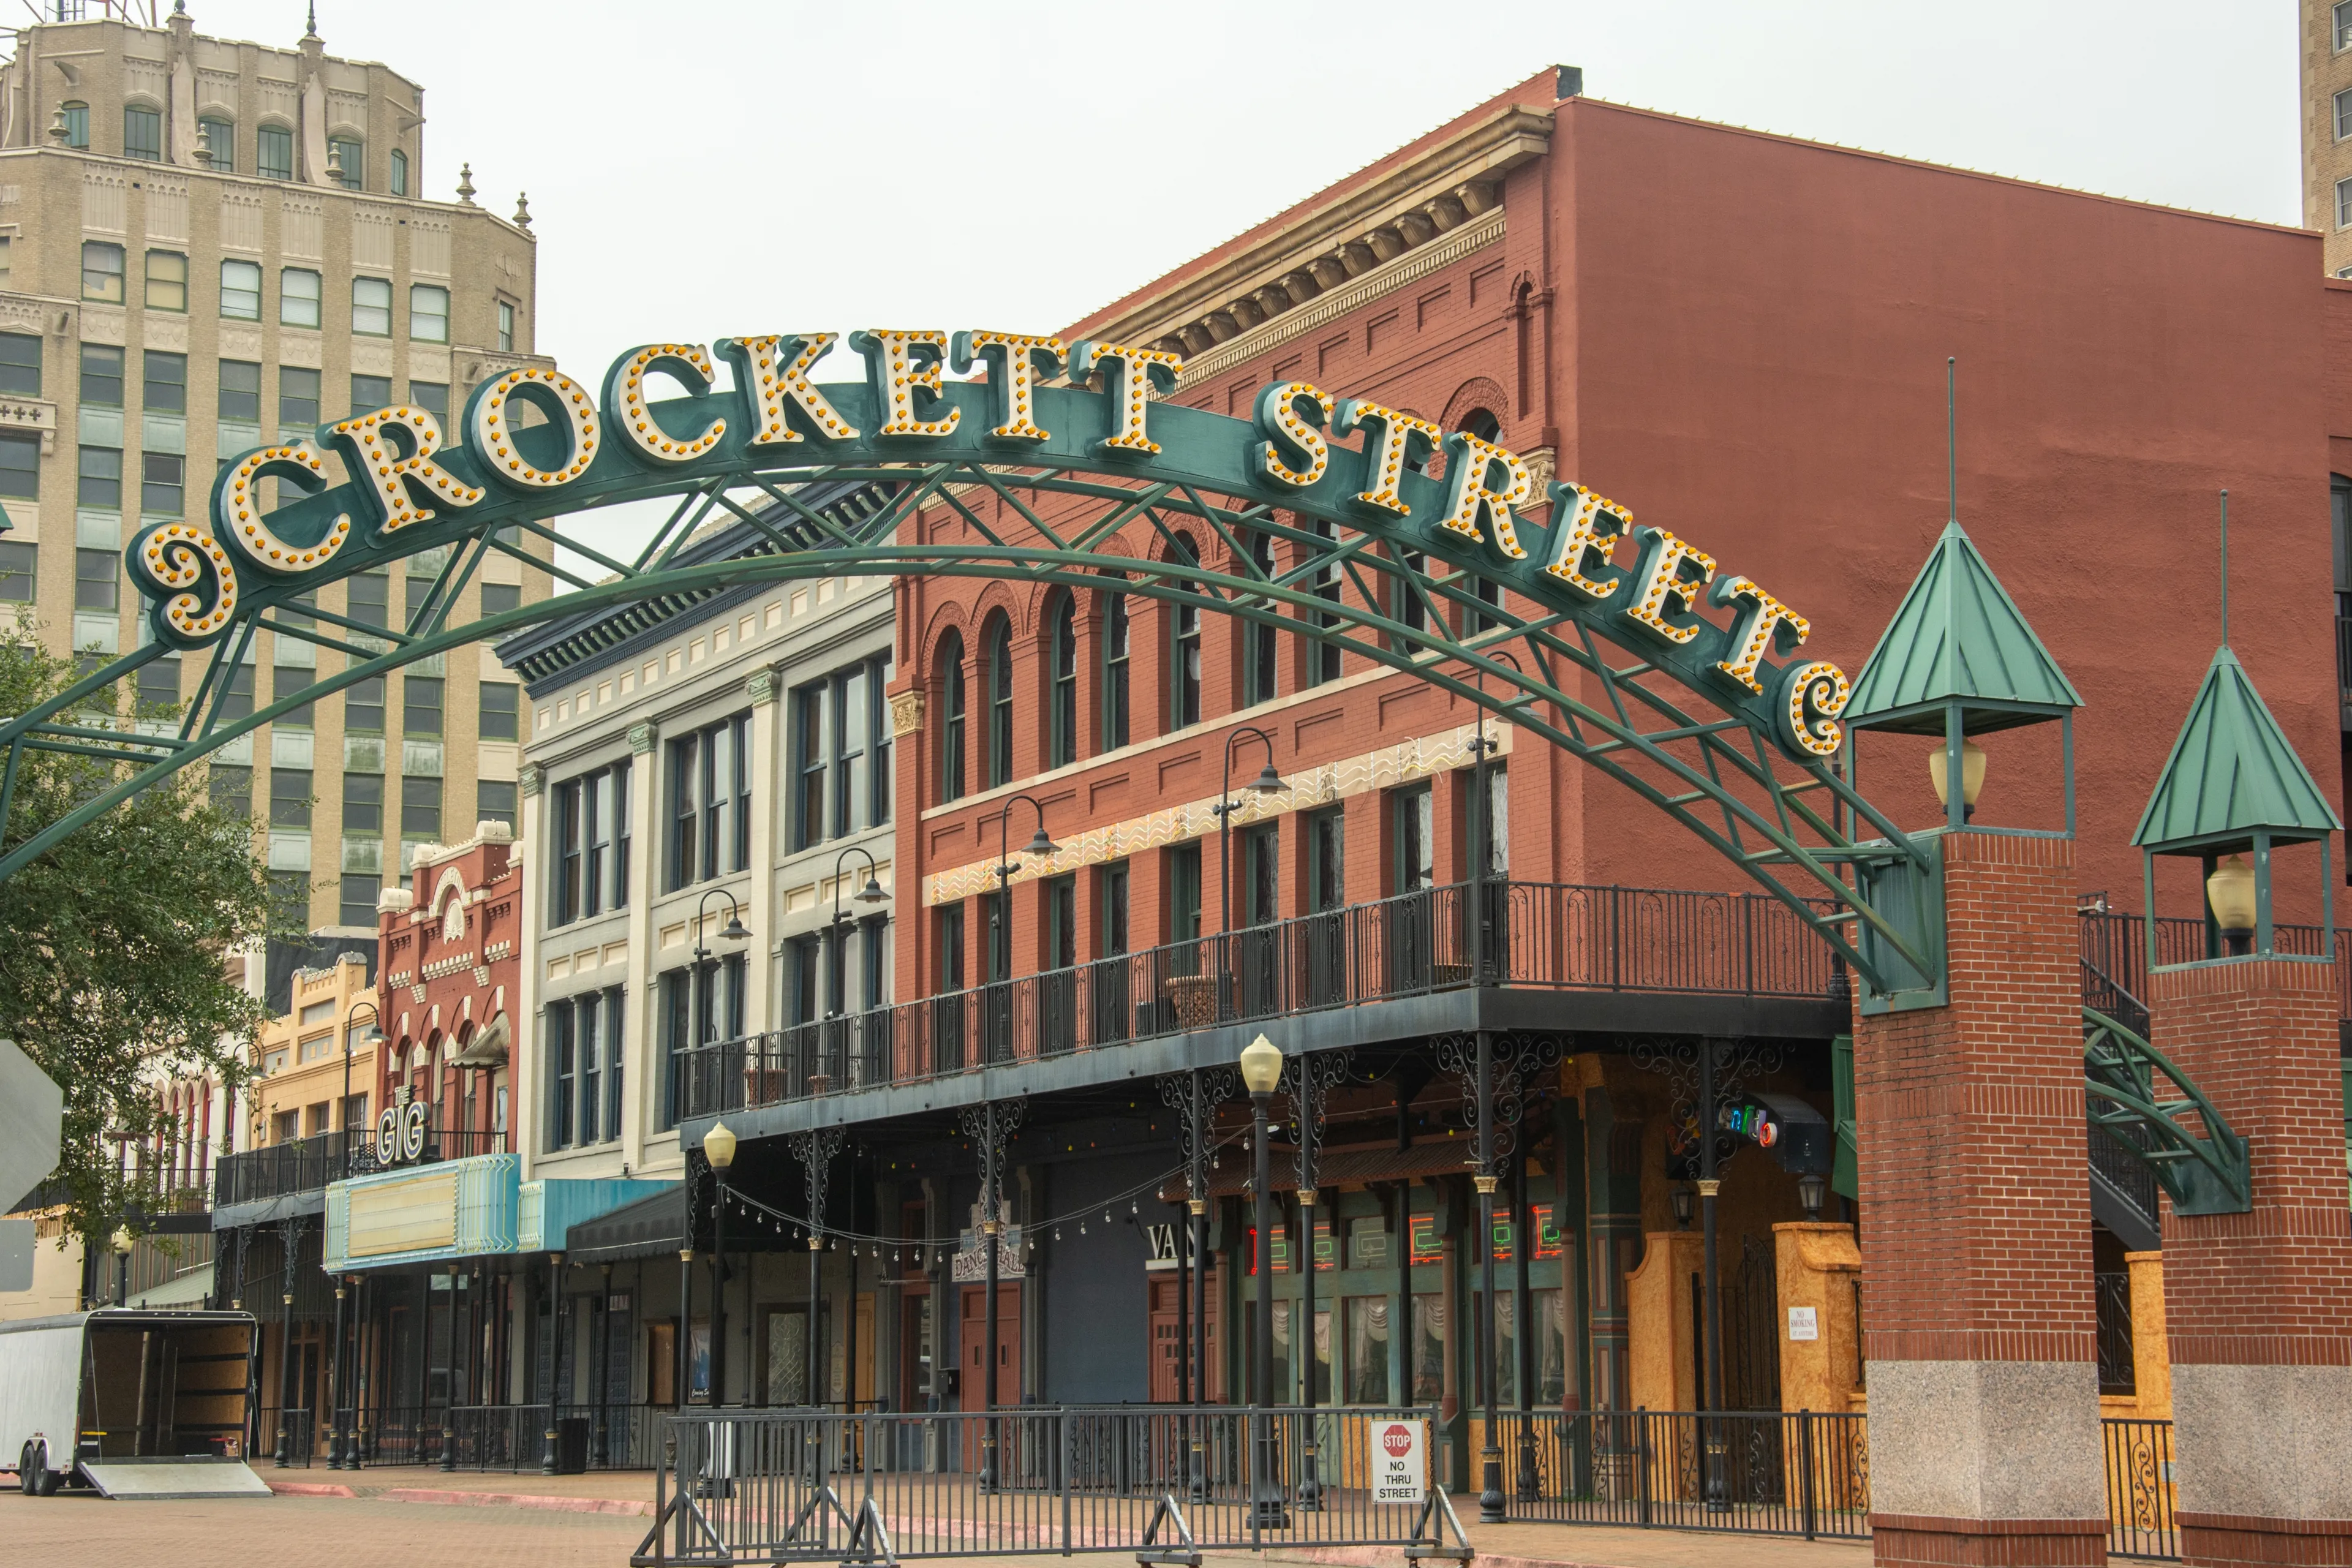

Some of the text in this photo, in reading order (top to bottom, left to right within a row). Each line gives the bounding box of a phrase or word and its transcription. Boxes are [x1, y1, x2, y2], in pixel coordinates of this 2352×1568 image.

[221, 329, 1811, 697] CROCKETT STREET
[394, 1085, 410, 1106] THE
[377, 1101, 426, 1164] GIG
[1790, 1319, 1815, 1328] SMOKING
[692, 1389, 704, 1397] Coming
[1384, 1435, 1411, 1447] STOP
[1390, 1461, 1405, 1471] NO
[1385, 1475, 1411, 1485] THRU
[1379, 1488, 1417, 1499] STREET
